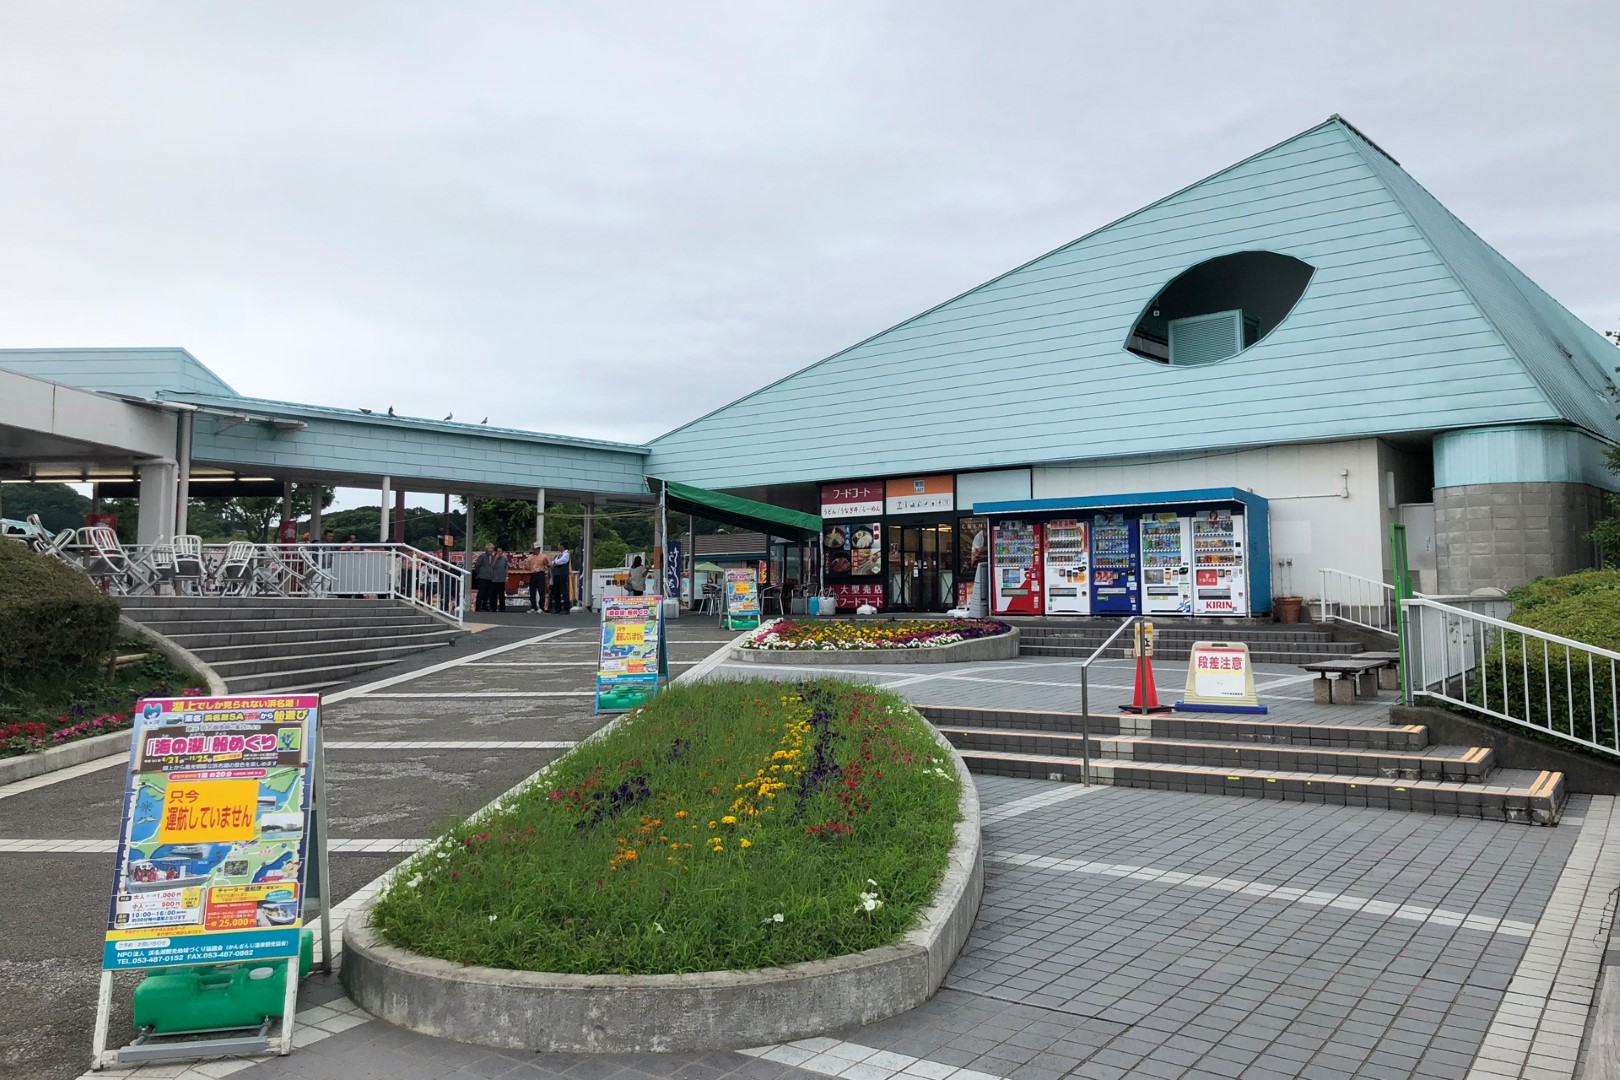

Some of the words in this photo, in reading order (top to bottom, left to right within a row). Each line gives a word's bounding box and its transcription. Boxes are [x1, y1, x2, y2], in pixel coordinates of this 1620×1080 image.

[833, 487, 871, 499] フードコート
[840, 584, 883, 595] 大型売店
[840, 597, 883, 607] フードコート
[1206, 601, 1233, 609] KIRIN
[1198, 655, 1243, 671] 段差注意
[168, 789, 200, 804] 只今
[164, 804, 253, 831] 運航していません
